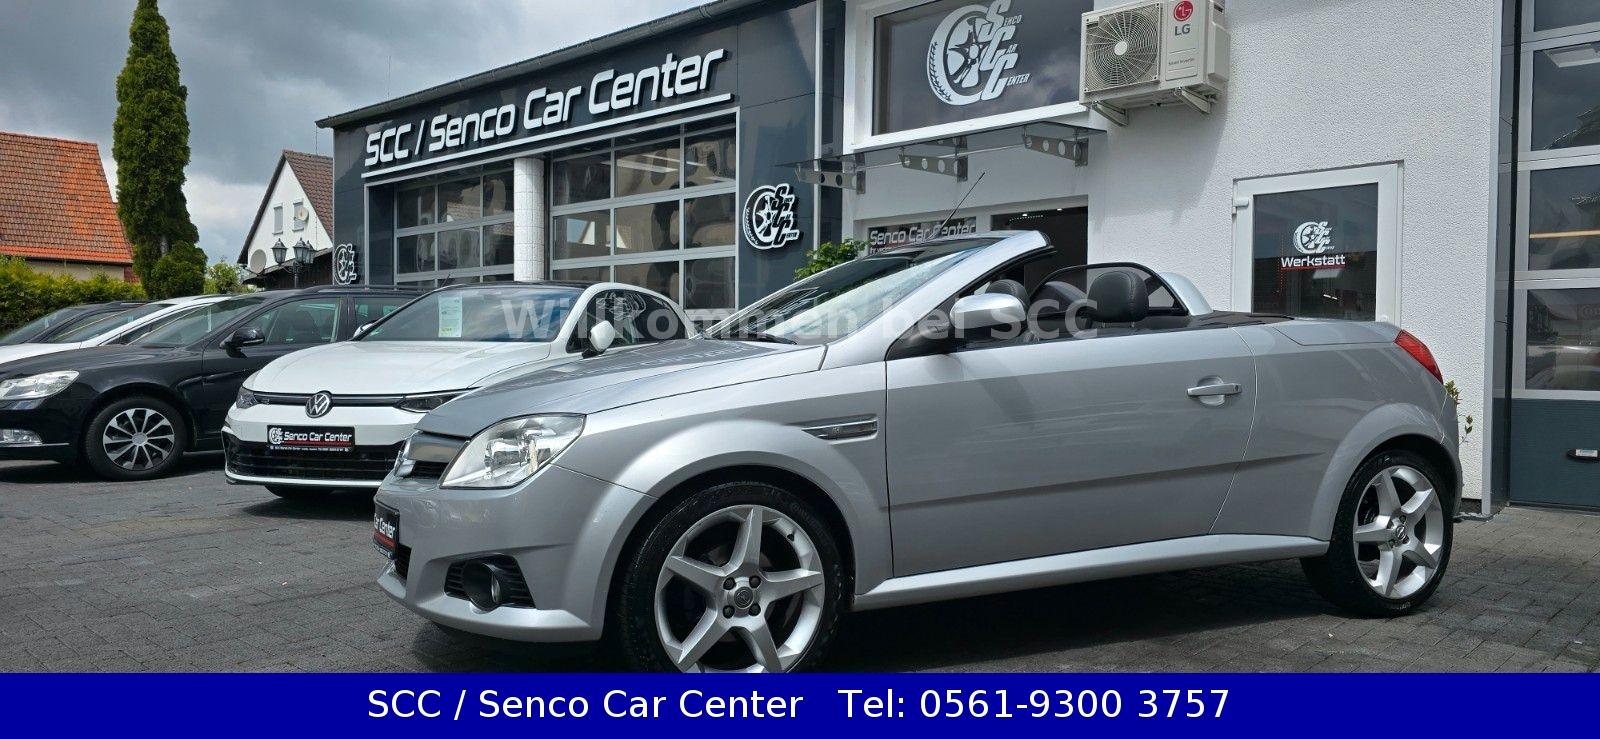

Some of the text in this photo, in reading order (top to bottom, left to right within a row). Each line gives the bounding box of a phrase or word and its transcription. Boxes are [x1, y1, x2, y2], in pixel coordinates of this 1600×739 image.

[1175, 23, 1191, 36] LG
[365, 49, 724, 166] SCC / Senco Car Center
[869, 229, 906, 246] Senco
[908, 226, 930, 243] Car
[1281, 254, 1346, 268] Werkstatt
[284, 431, 352, 442] Senco Car Center
